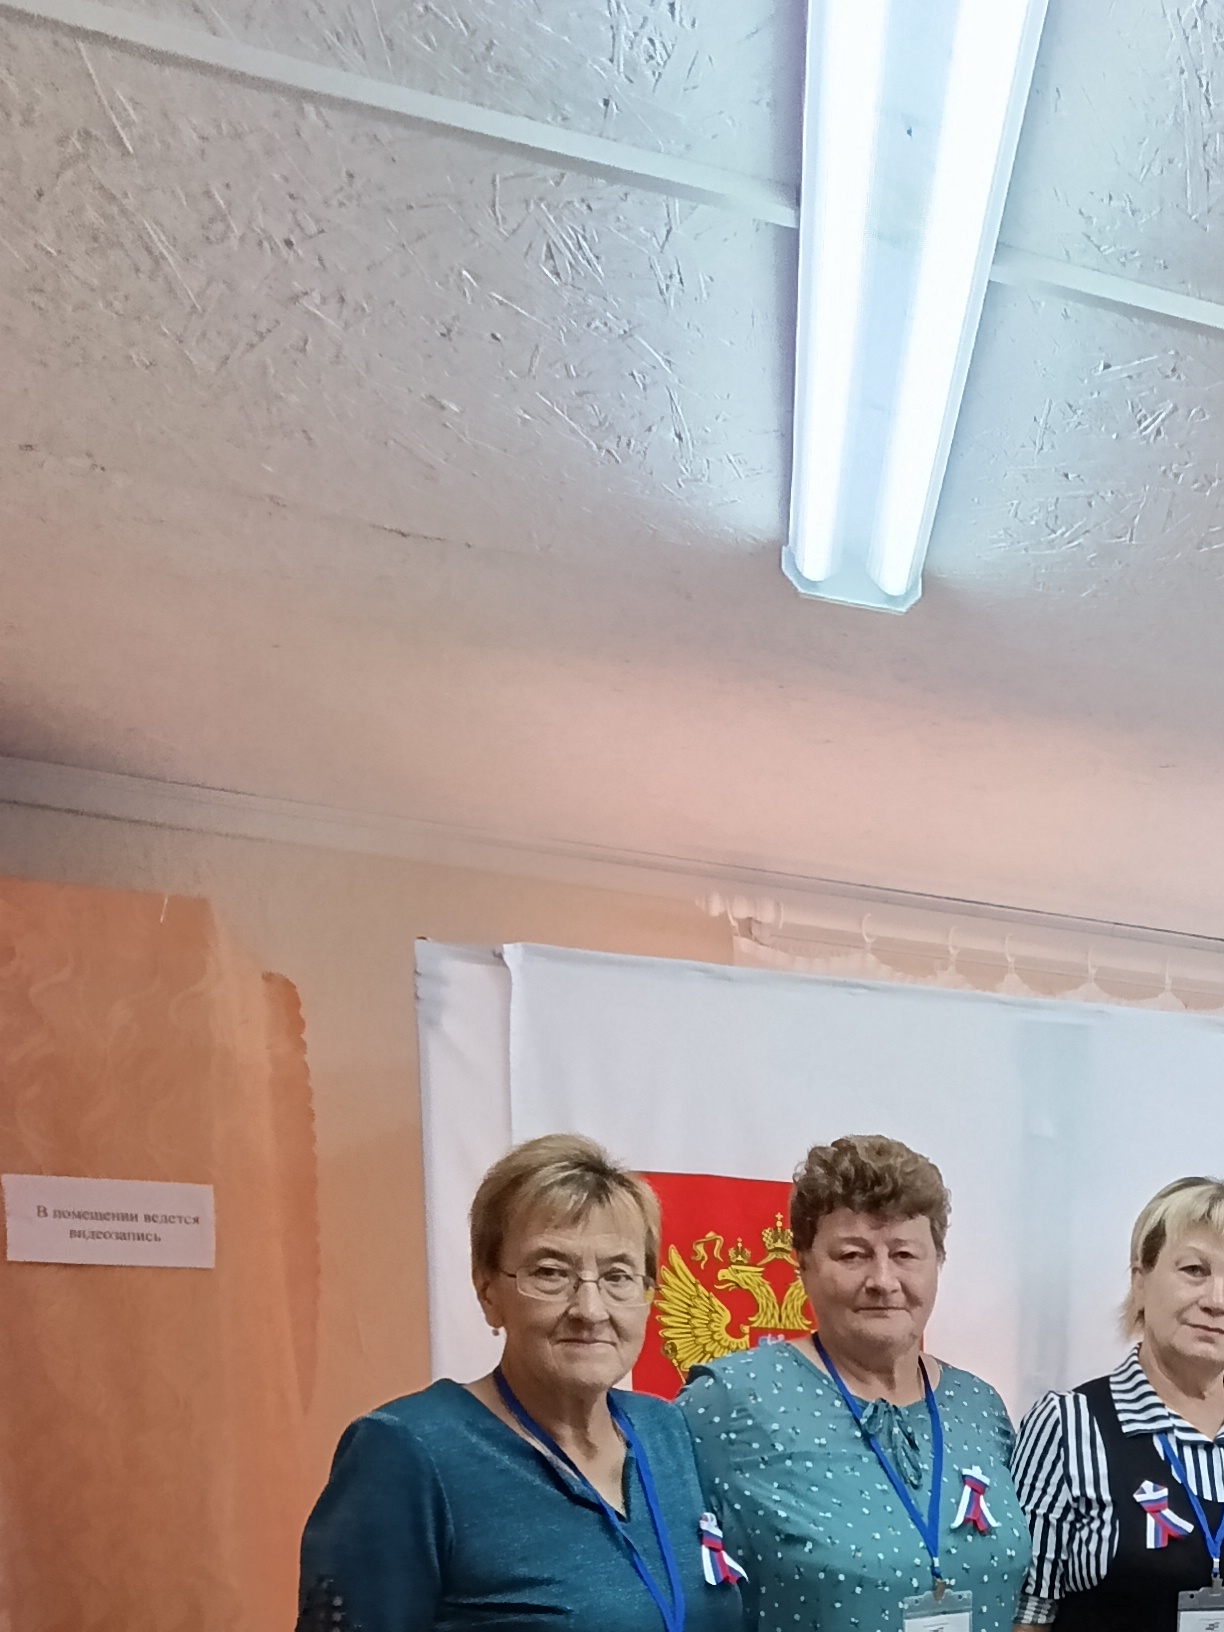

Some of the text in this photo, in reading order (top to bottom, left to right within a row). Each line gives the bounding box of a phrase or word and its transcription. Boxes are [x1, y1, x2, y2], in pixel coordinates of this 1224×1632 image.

[36, 1204, 200, 1225] В помещении ведется
[68, 1229, 162, 1243] видеозапись
